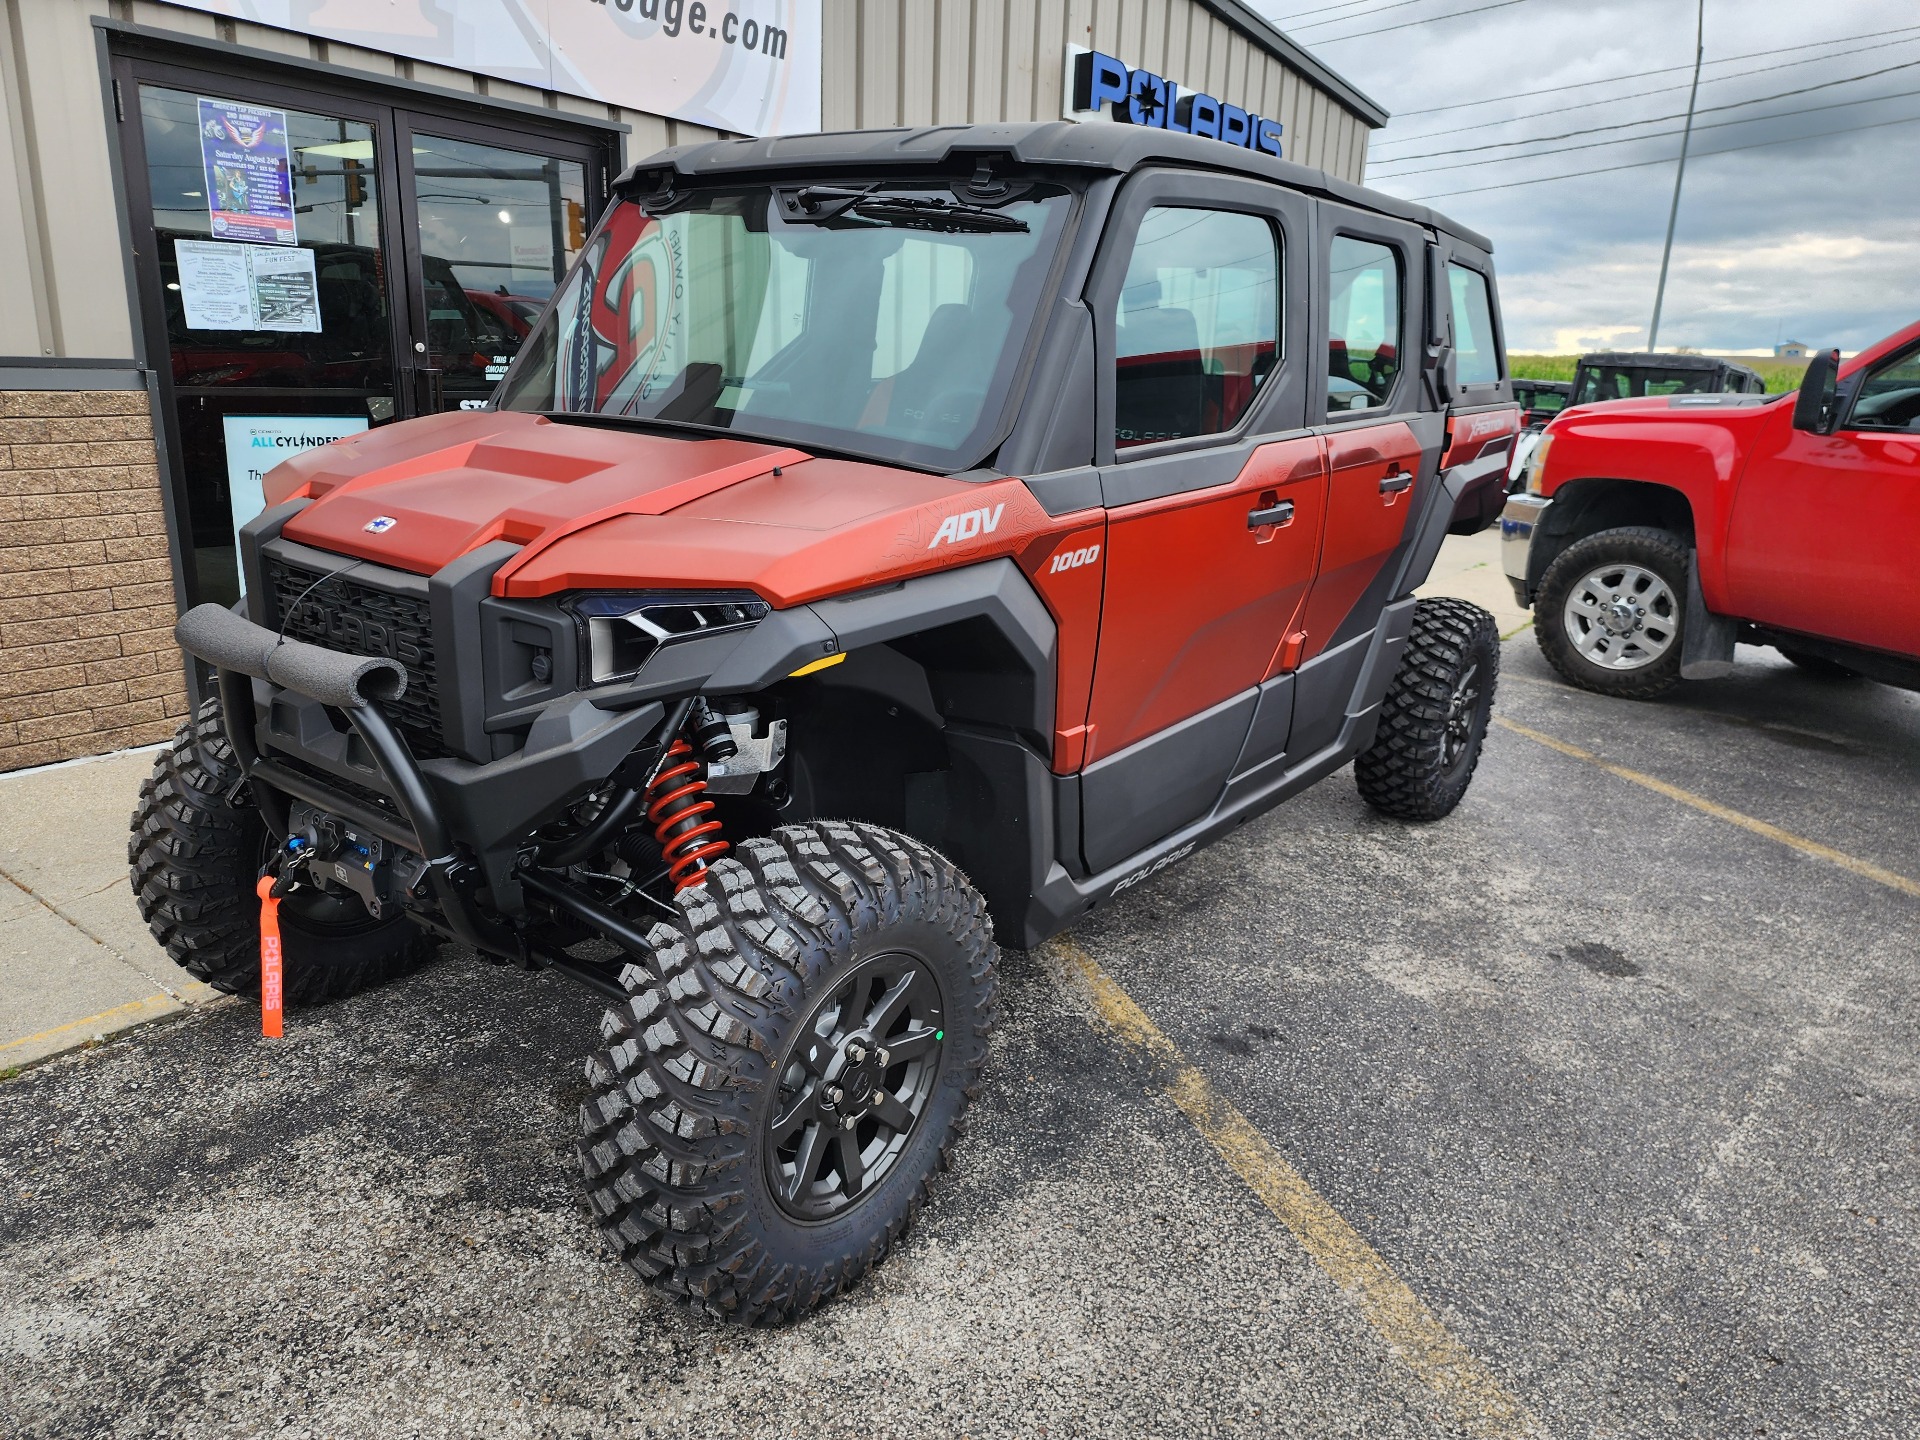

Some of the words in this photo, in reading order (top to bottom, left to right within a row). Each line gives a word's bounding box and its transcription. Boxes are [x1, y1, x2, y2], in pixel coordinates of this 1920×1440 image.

[238, 113, 260, 122] ANNUAL
[1078, 50, 1283, 159] POLARIS
[215, 149, 244, 162] Saturday
[244, 153, 266, 165] August
[266, 157, 280, 165] 24th
[279, 255, 295, 263] FEST
[927, 503, 1005, 550] ADV
[1050, 544, 1101, 574] 1000
[281, 594, 423, 666] POLARIS
[1109, 841, 1197, 888] POLARIS
[264, 936, 280, 1011] POLARIS
